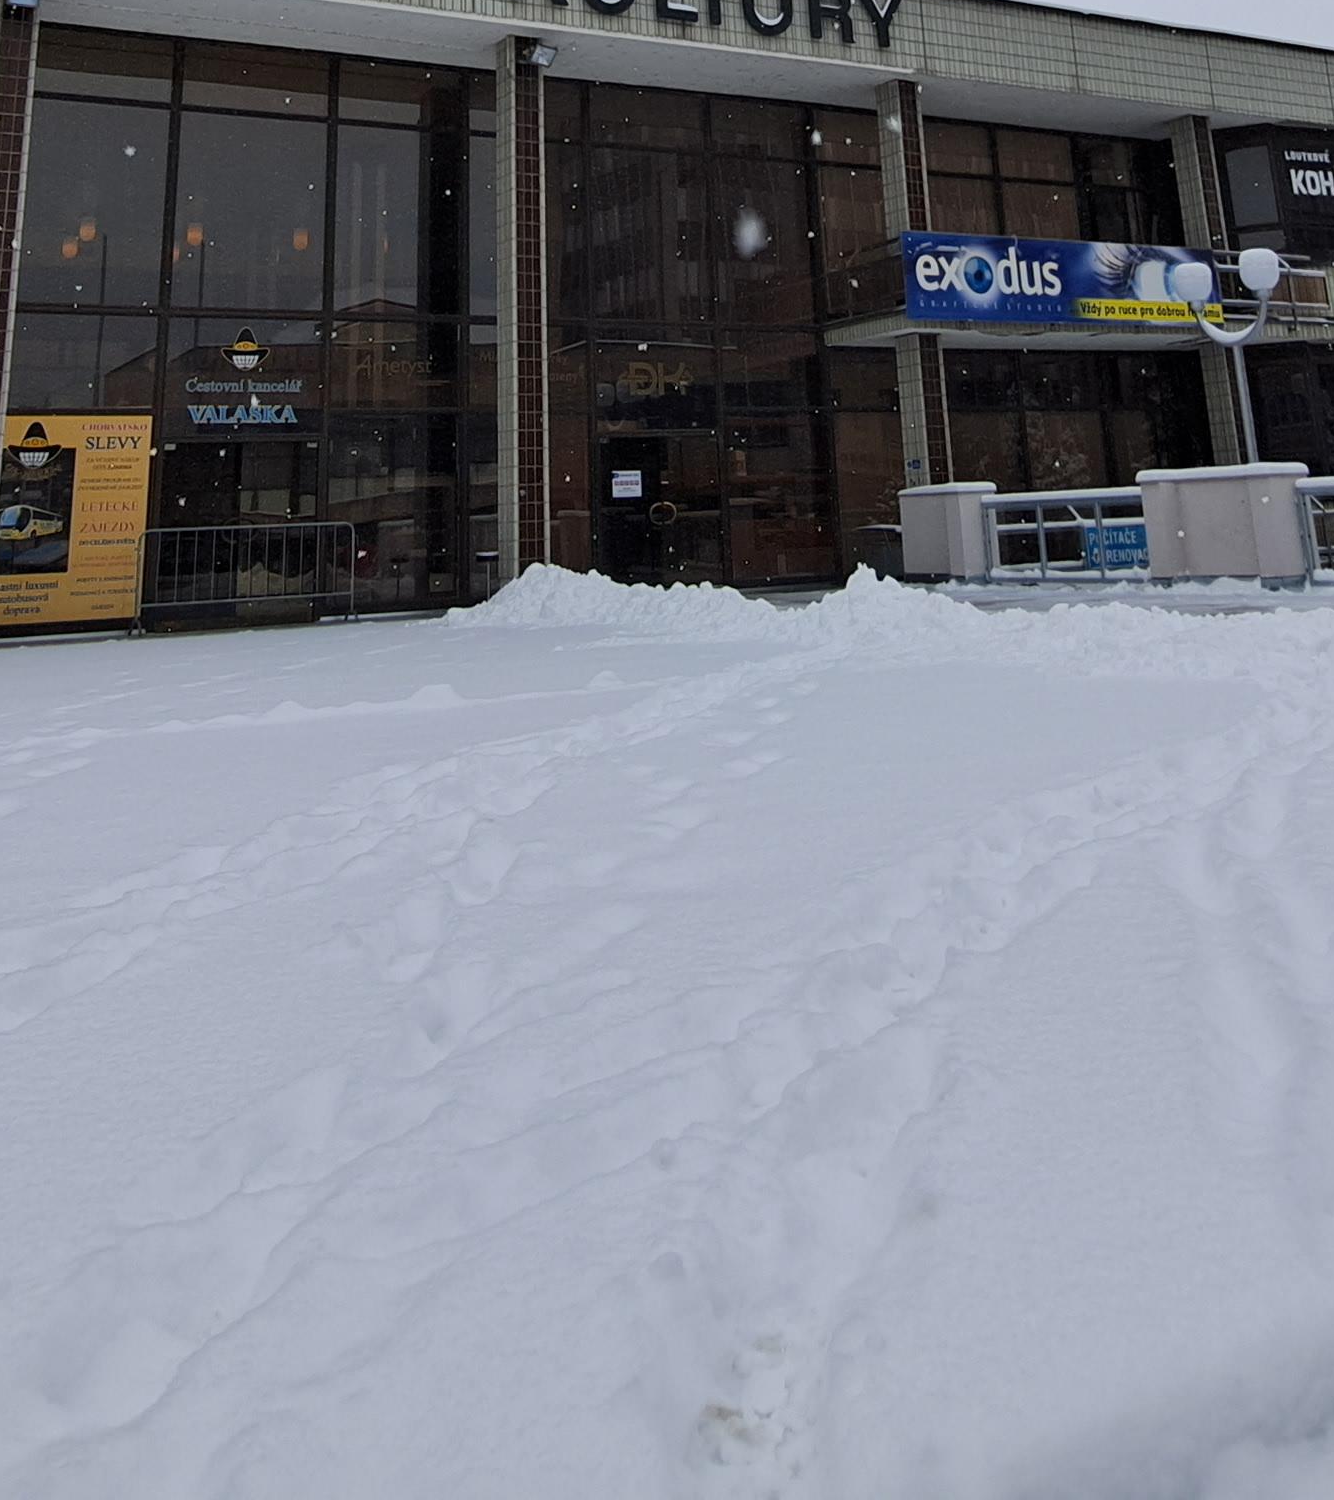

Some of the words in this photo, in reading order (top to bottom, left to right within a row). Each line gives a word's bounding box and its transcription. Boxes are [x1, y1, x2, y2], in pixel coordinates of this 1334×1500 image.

[915, 247, 1062, 297] exodus
[1104, 305, 1116, 316] po
[1118, 305, 1137, 315] ruce
[1140, 306, 1154, 318] pro
[1156, 305, 1185, 317] dobrou
[185, 379, 244, 393] Cestovní
[247, 379, 303, 393] kancelář
[85, 436, 142, 450] SLEVY
[1105, 548, 1148, 564] RENOVAC
